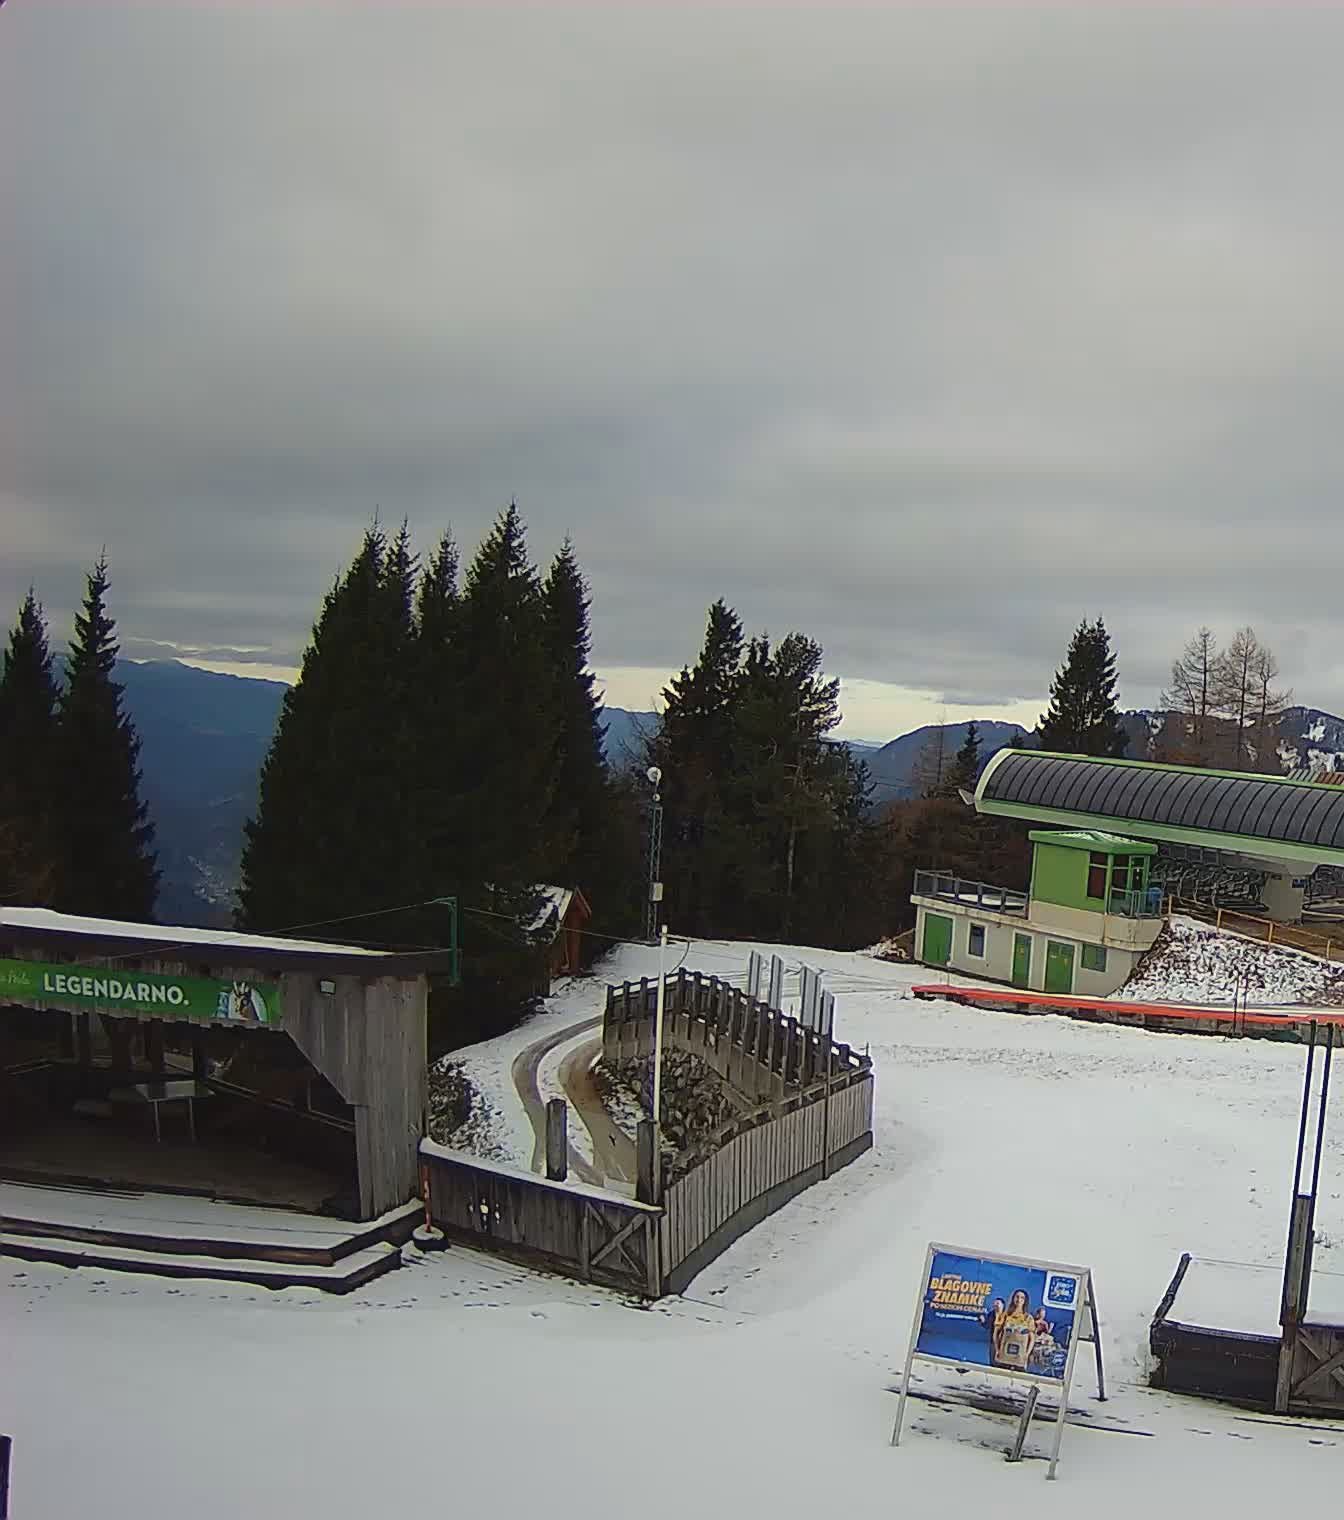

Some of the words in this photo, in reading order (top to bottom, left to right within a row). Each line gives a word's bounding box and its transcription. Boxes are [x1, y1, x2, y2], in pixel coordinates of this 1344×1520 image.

[43, 973, 190, 1006] LEGENDARNO.
[930, 1277, 992, 1295] BLAGOVNE
[933, 1290, 986, 1306] ZNAMKE
